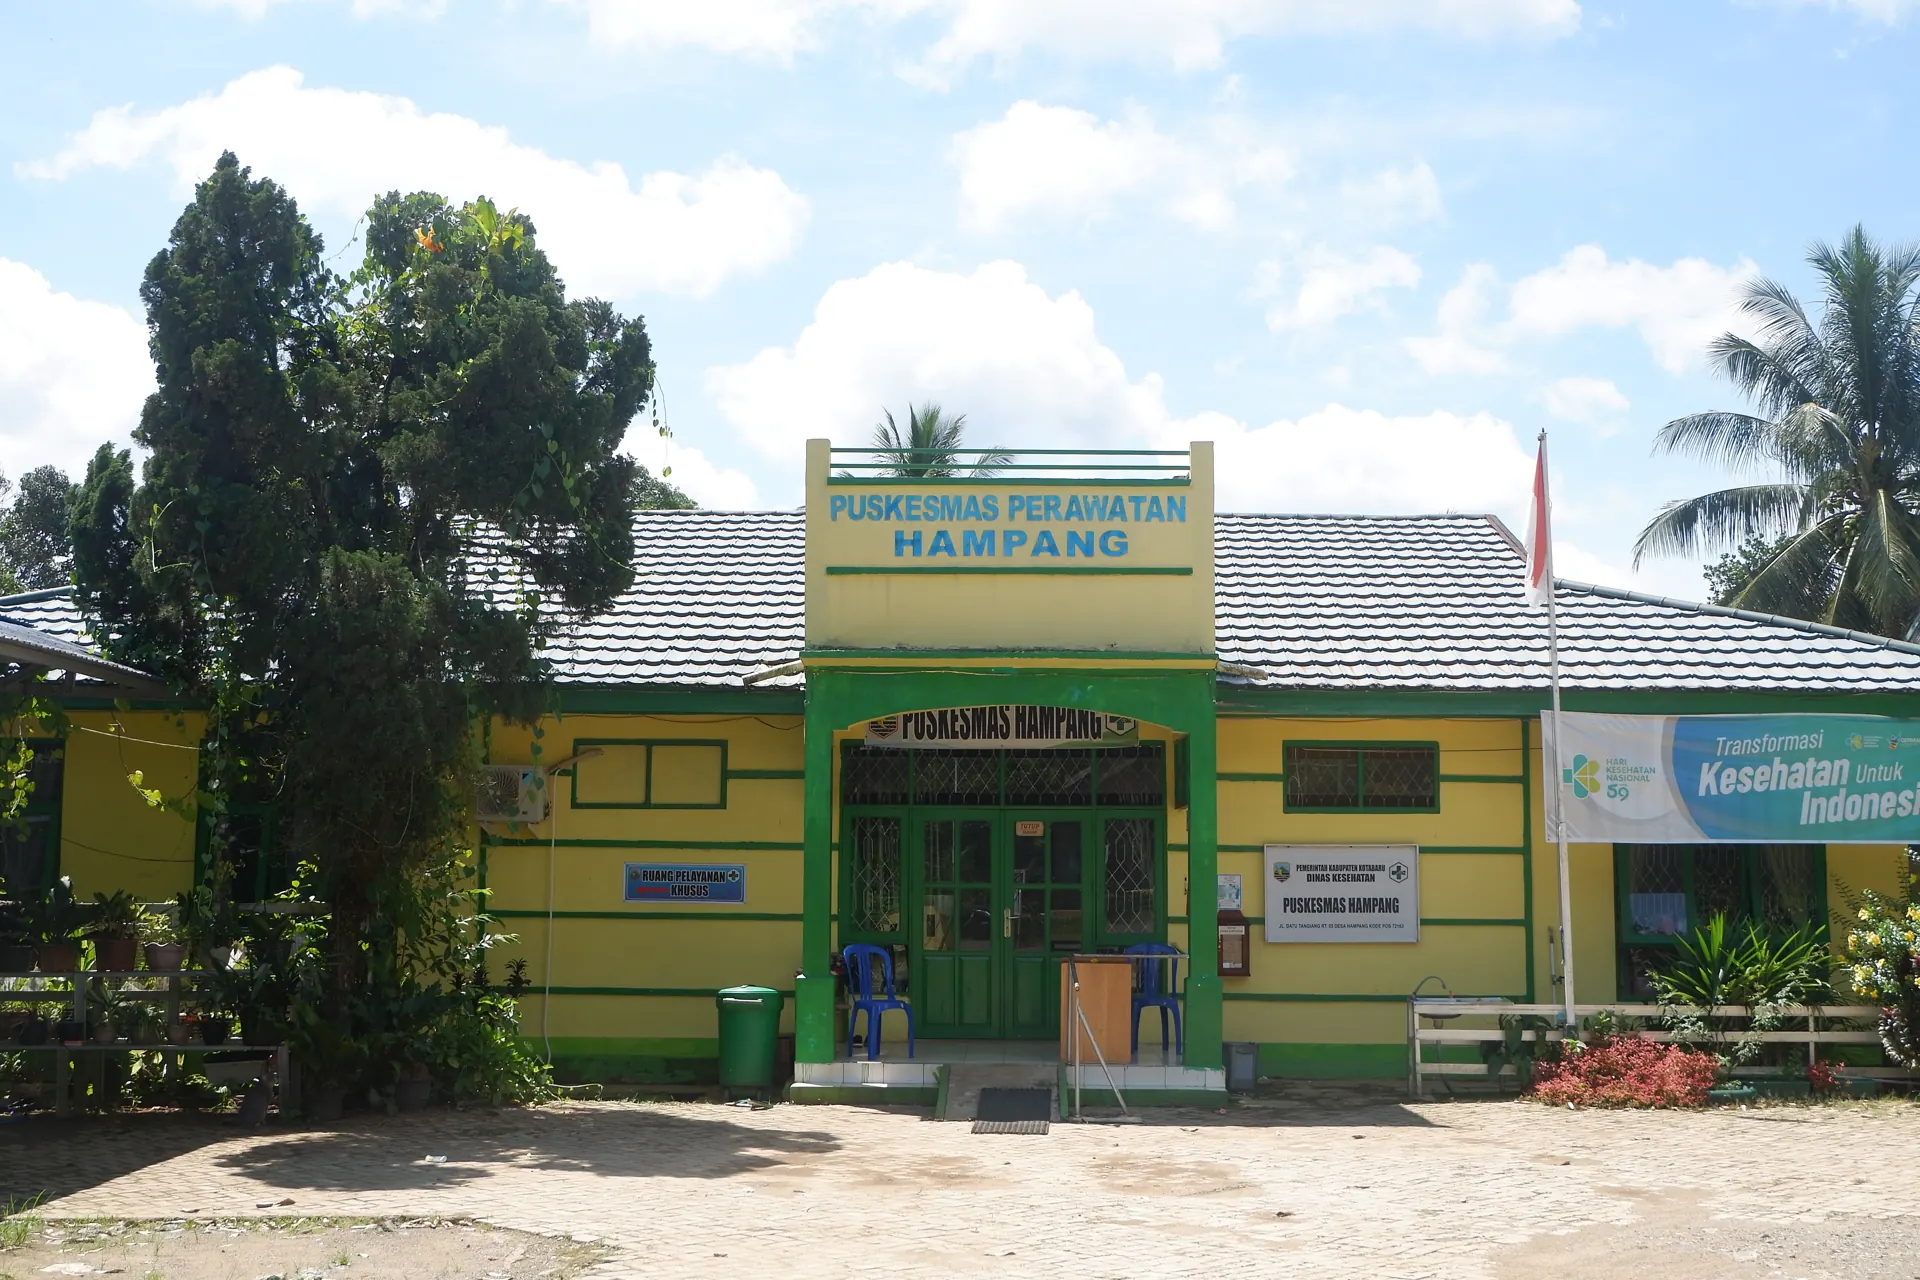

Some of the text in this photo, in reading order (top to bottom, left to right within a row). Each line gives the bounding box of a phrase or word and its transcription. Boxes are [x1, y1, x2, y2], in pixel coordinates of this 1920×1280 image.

[830, 495, 1187, 522] PUSKESMAS PERAWATAN
[893, 530, 1129, 557] HAMPANG
[902, 705, 1102, 740] PUSKESMAS HAMPANG
[1716, 729, 1825, 757] Transformasi
[1606, 758, 1627, 766] HARI
[1606, 766, 1656, 774] KESEHATAN
[1699, 756, 1904, 797] Kesehatan Untuk
[1606, 774, 1651, 782] NASIONAL
[1607, 784, 1629, 802] 59
[1296, 864, 1386, 872] PEMERINTAH KABUPATEN KOTABARU
[642, 869, 726, 883] RUANG PELAYANAN
[1306, 873, 1376, 883] DINAS KESEHATAN
[671, 884, 709, 897] KHUSUS
[1283, 897, 1400, 914] PUSKESMAS HAMPANG
